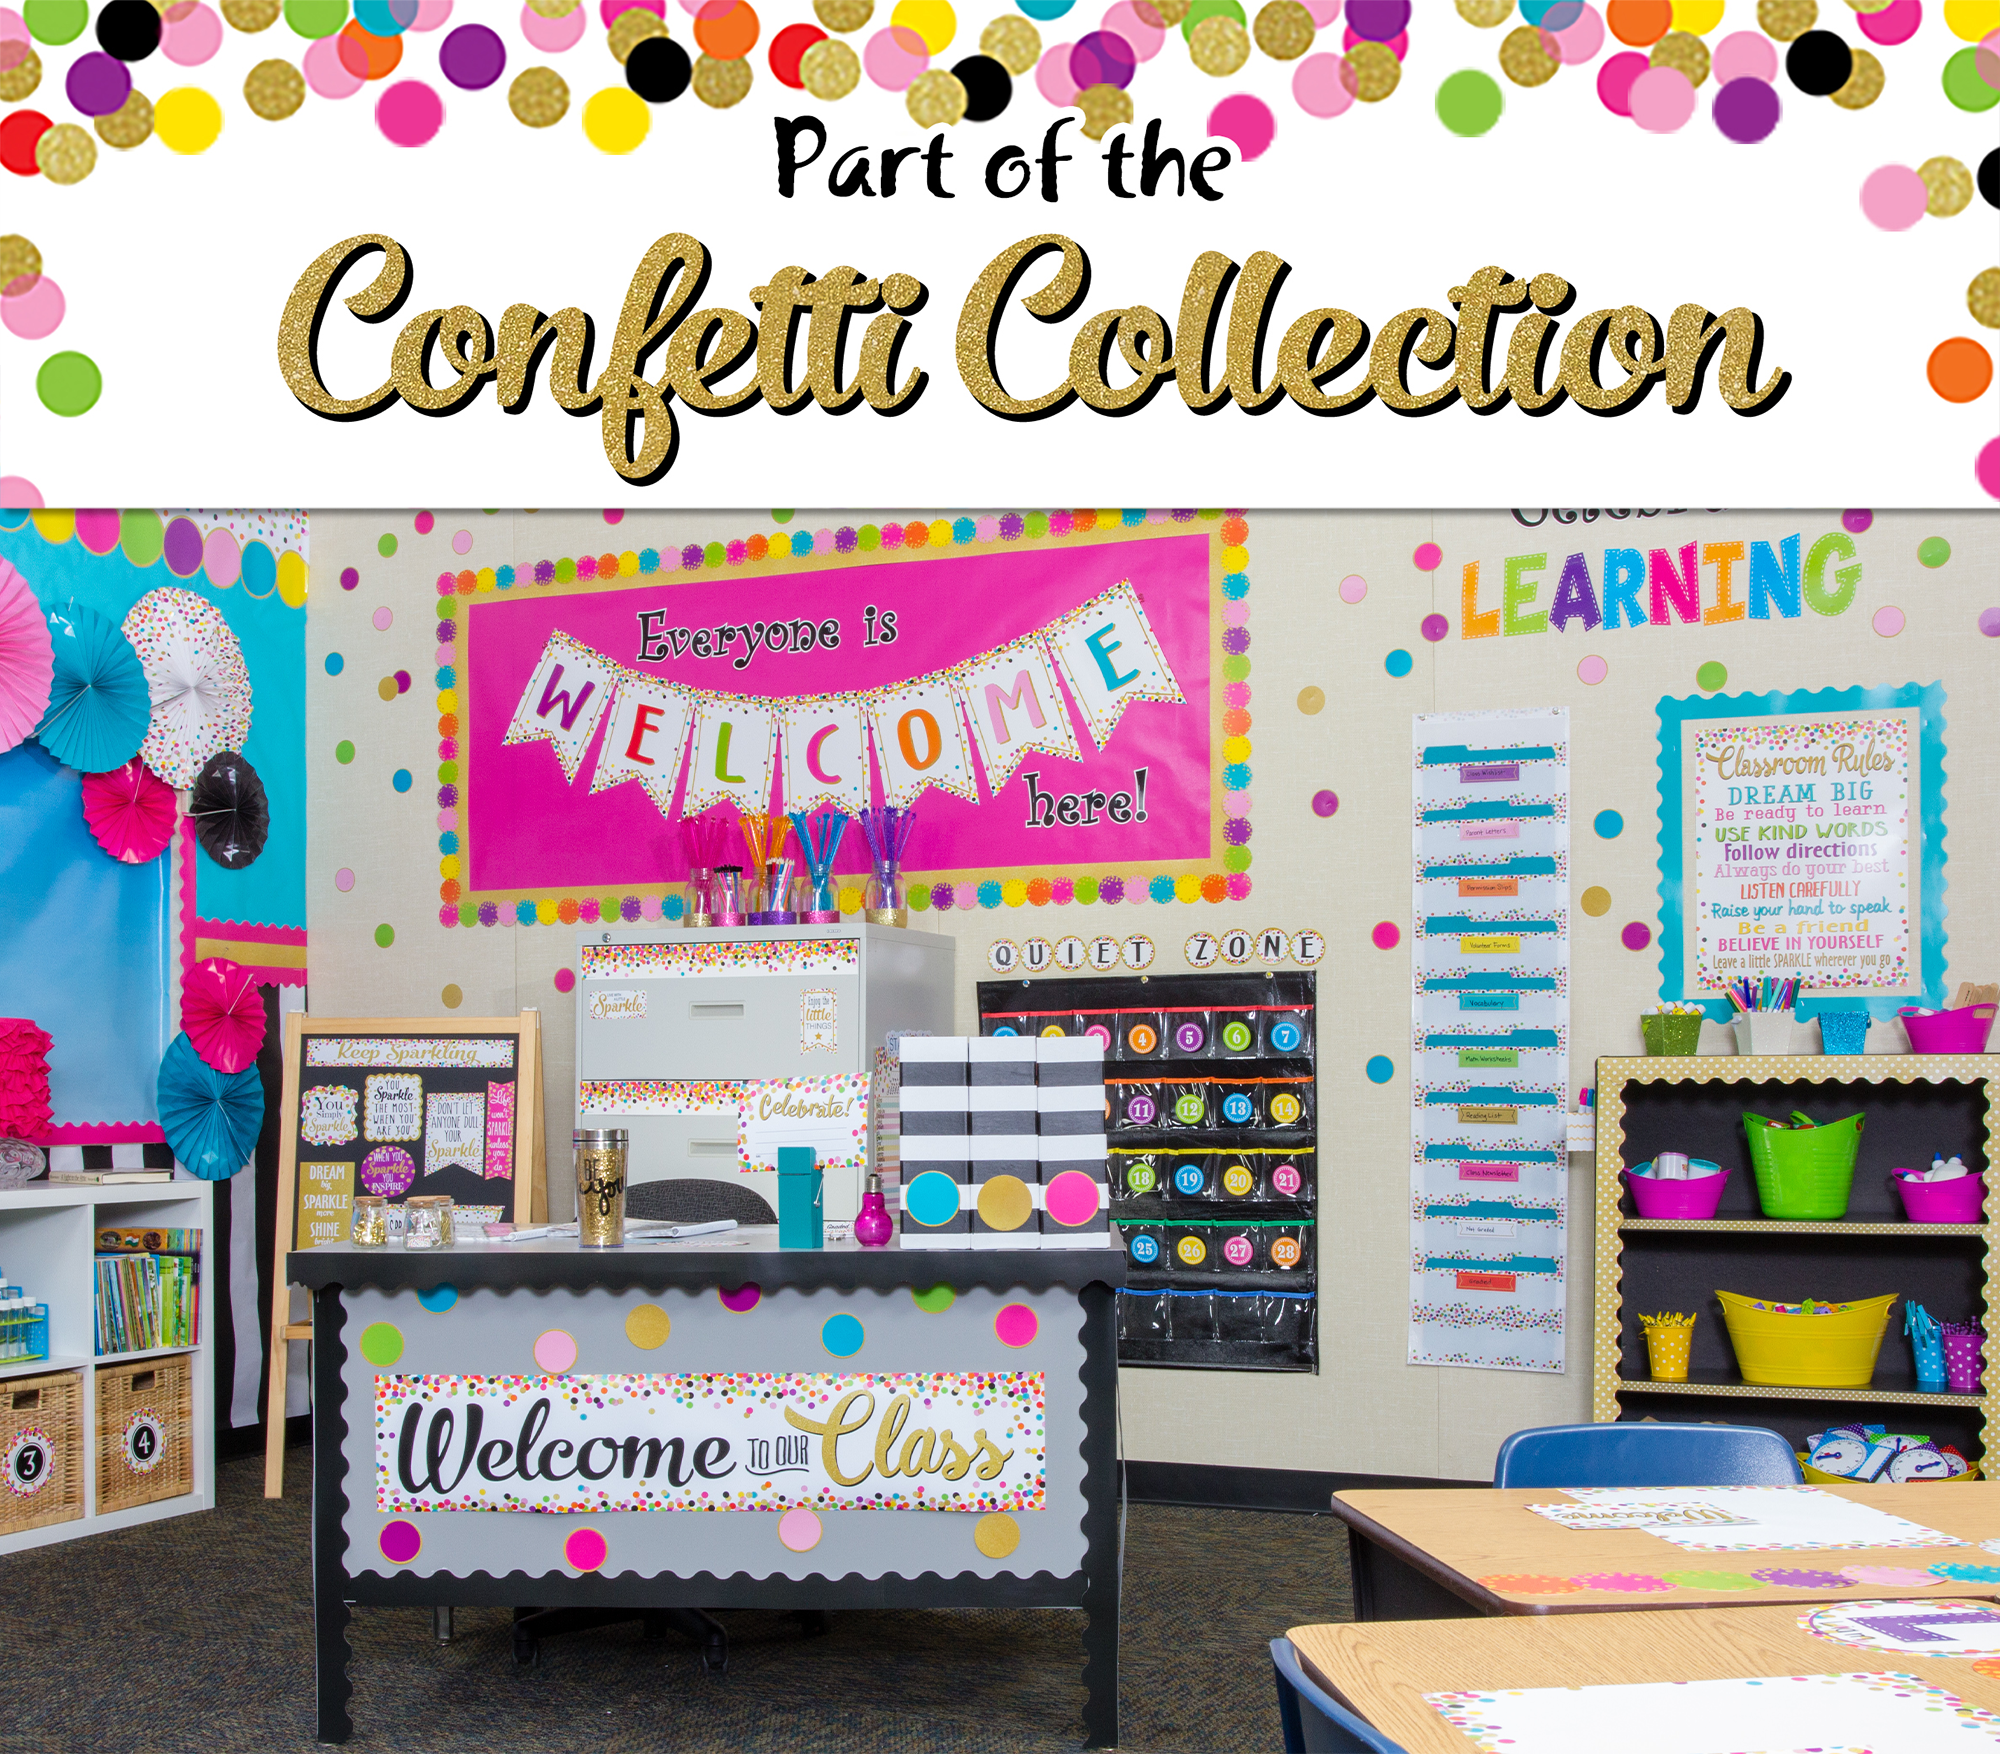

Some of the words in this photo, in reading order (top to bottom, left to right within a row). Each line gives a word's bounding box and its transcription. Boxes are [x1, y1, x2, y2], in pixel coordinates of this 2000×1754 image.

[1461, 532, 1863, 640] LEARNING
[635, 607, 841, 671] Everyone
[863, 605, 899, 647] is
[536, 621, 1142, 785] WELCOME
[1705, 744, 1826, 781] Classroom
[1831, 736, 1896, 778] Rules
[1023, 767, 1149, 829] here!
[1727, 783, 1817, 806] DREAM
[1830, 780, 1874, 802] BIG
[1714, 807, 1735, 821] Be
[1743, 805, 1797, 823] ready
[1806, 804, 1825, 817] to
[1833, 803, 1888, 817] learn
[1714, 826, 1751, 842] USE
[1758, 823, 1808, 841] KIND
[1815, 820, 1889, 839] WORDS
[1724, 844, 1780, 862] Follow
[1786, 842, 1878, 859] directions
[1713, 863, 1778, 881] Always
[1781, 862, 1801, 876] do
[1806, 862, 1847, 880] your
[1851, 859, 1890, 874] best
[1740, 882, 1785, 900] LISTEN
[1789, 880, 1861, 899] CAREFULLY
[1711, 902, 1750, 919] Raise
[1753, 904, 1784, 921] your
[1788, 898, 1825, 916] hand
[1828, 900, 1846, 915] to
[1849, 896, 1893, 921] speak
[1738, 921, 1766, 935] Be
[1774, 923, 1787, 934] a
[1796, 918, 1869, 934] friend
[994, 940, 1145, 967] QUIET
[1194, 934, 1316, 961] ZONE
[1718, 937, 1780, 952] BELIEVE
[1785, 936, 1801, 951] IN
[1807, 934, 1885, 950] YOURSELF
[1712, 954, 1738, 970] Leave
[1740, 958, 1746, 969] a
[1748, 953, 1771, 968] little
[1773, 952, 1812, 968] SPARKLE
[1814, 952, 1858, 967] wherever
[1860, 954, 1877, 969] you
[1879, 954, 1891, 969] go
[593, 993, 644, 1018] Sparkle
[807, 996, 821, 1008] Enjoy
[822, 995, 830, 1006] the
[805, 1007, 832, 1021] little
[805, 1022, 832, 1030] THINGS
[1138, 1032, 1147, 1046] 4
[1185, 1031, 1194, 1045] 5
[1232, 1029, 1241, 1044] 6
[1281, 1029, 1290, 1044] 7
[337, 1041, 380, 1064] Keep
[386, 1040, 481, 1067] Sparkling
[374, 1085, 414, 1102] Sparkle
[385, 1080, 400, 1091] YOU
[315, 1096, 343, 1110] You
[490, 1089, 511, 1106] Life
[375, 1103, 388, 1113] THE
[392, 1102, 413, 1113] MOST
[437, 1102, 458, 1115] DON'T
[462, 1101, 473, 1114] LET
[491, 1108, 509, 1119] won't
[758, 1092, 855, 1121] Celebrate!
[1134, 1103, 1150, 1118] 11
[1181, 1102, 1198, 1117] 12
[1230, 1101, 1247, 1115] 13
[1276, 1101, 1295, 1116] 14
[316, 1111, 343, 1120] Simply
[373, 1114, 395, 1125] WHEN
[399, 1114, 414, 1124] YOU
[431, 1116, 461, 1128] ANYONE
[464, 1116, 479, 1128] DULL
[1466, 1111, 1488, 1122] Reading
[309, 1116, 350, 1136] Sparkle
[376, 1125, 391, 1136] ARE
[396, 1125, 411, 1135] YOU
[487, 1121, 511, 1136] SPARKLE
[444, 1129, 462, 1142] YOUR
[489, 1137, 509, 1149] unless
[373, 1152, 390, 1162] WHEN
[391, 1151, 403, 1162] YOU
[428, 1137, 480, 1163] Sparkle
[492, 1149, 505, 1161] you
[309, 1165, 345, 1180] DREAM
[366, 1159, 409, 1178] Sparkle
[493, 1161, 503, 1171] do
[584, 1158, 600, 1181] BE
[321, 1180, 332, 1191] big
[372, 1182, 404, 1191] INSPIRE
[382, 1173, 394, 1183] YOU
[1133, 1170, 1150, 1185] 18
[1181, 1172, 1198, 1187] 19
[1229, 1173, 1247, 1188] 20
[1278, 1172, 1295, 1187] 21
[303, 1194, 348, 1209] SPARKLE
[579, 1176, 624, 1217] you
[310, 1222, 340, 1238] SHINE
[1136, 1242, 1153, 1256] 25
[1183, 1243, 1201, 1258] 26
[1230, 1243, 1247, 1258] 27
[1277, 1245, 1295, 1259] 28
[138, 1430, 151, 1455] 4
[783, 1387, 1015, 1487] Class
[398, 1397, 737, 1495] Welcome
[747, 1437, 769, 1469] TO
[775, 1434, 809, 1467] OUR
[23, 1450, 37, 1476] 3
[1554, 1508, 1736, 1522] Welcome
